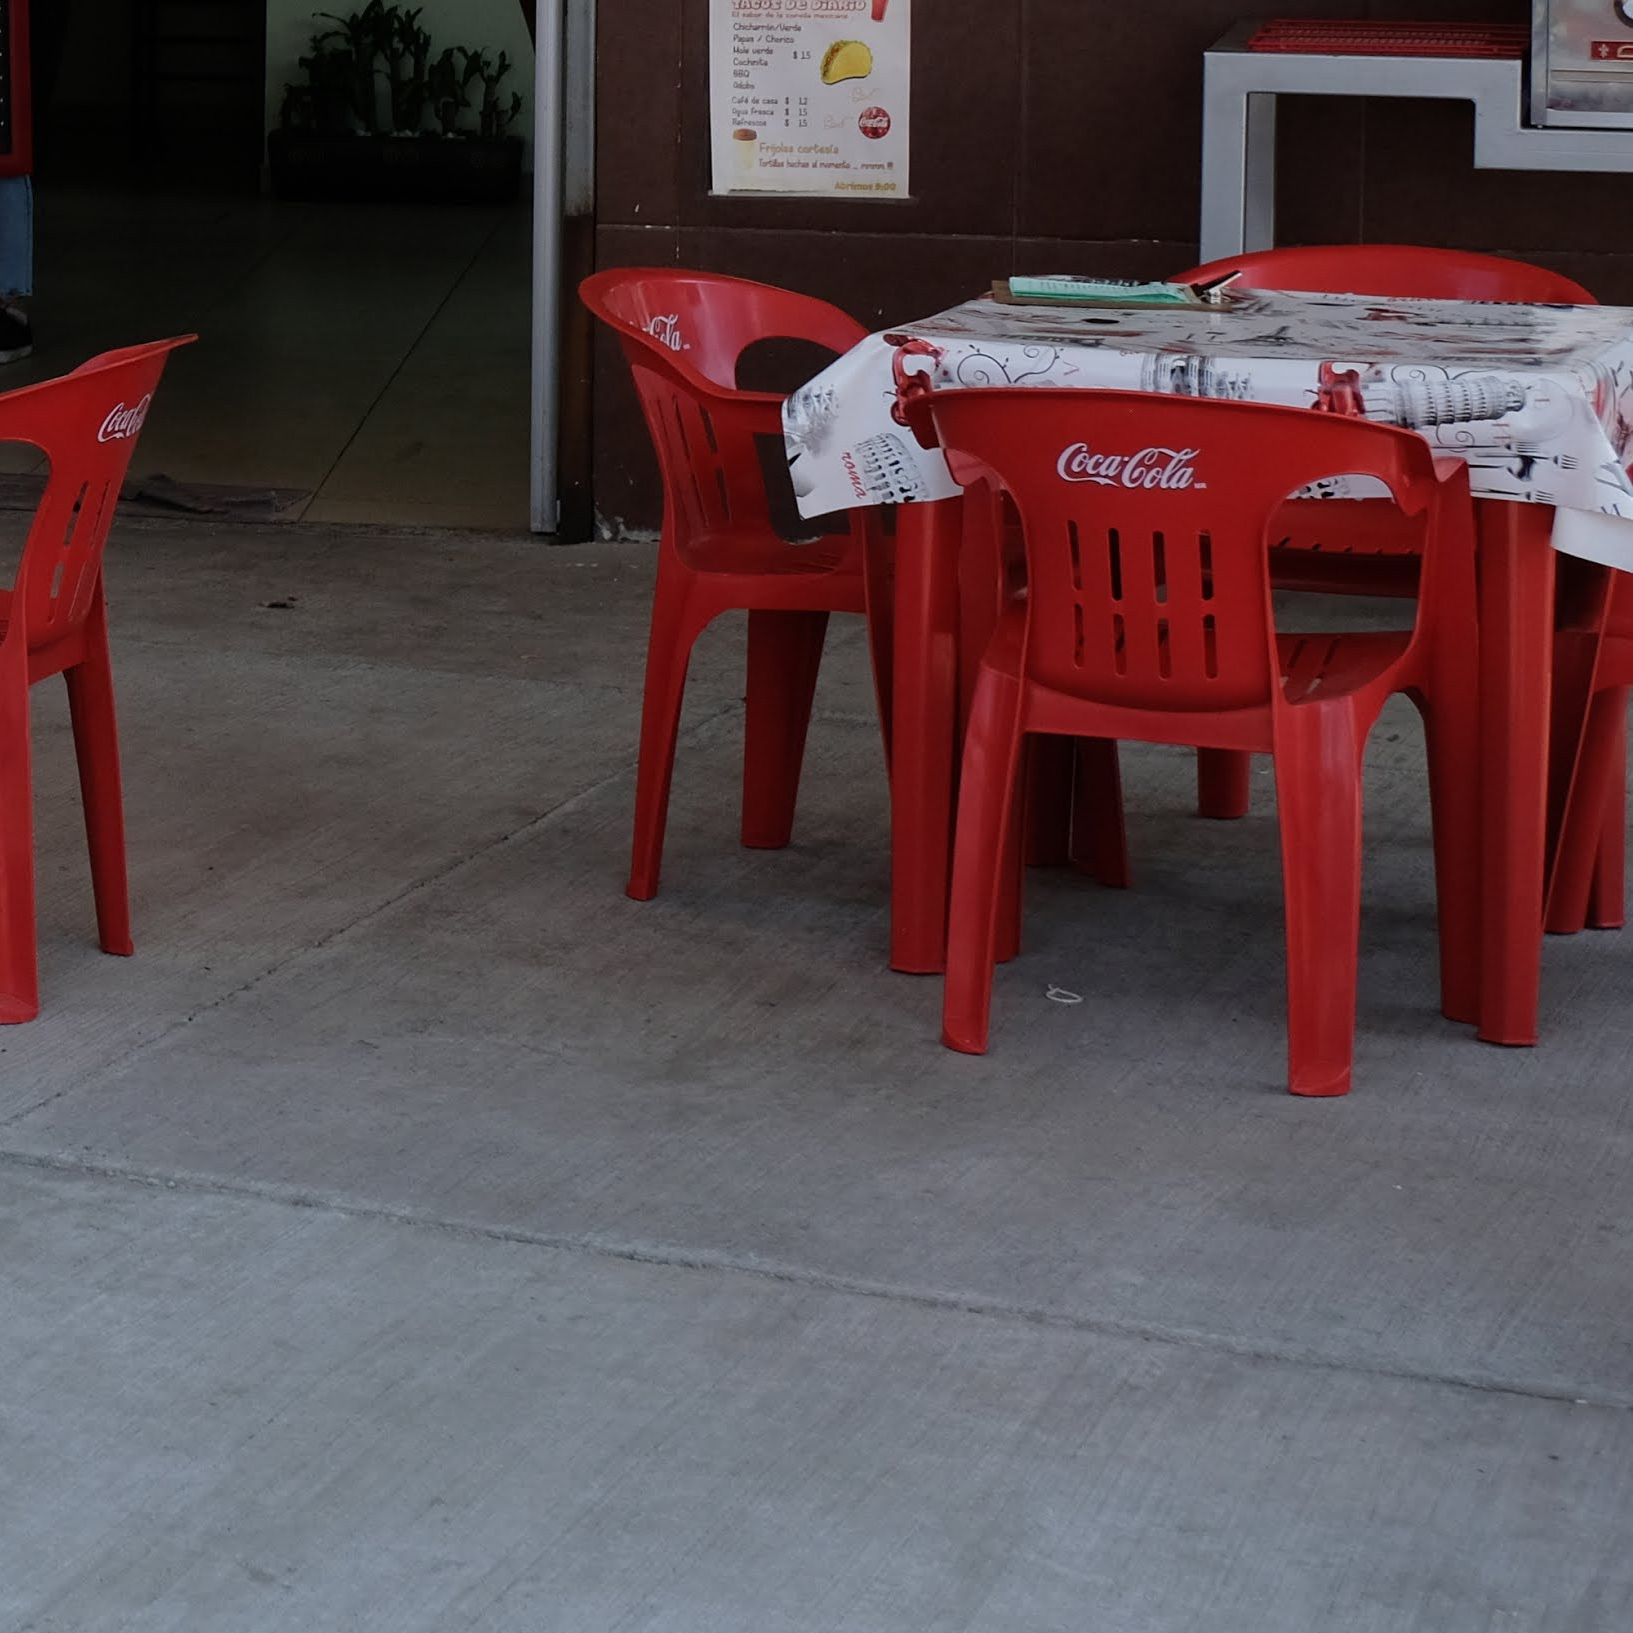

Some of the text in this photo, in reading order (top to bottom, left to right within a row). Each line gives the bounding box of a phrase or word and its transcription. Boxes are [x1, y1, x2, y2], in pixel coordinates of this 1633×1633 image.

[732, 0, 782, 10] TACOS
[801, 51, 811, 60] 15
[733, 69, 750, 78] BBQ
[798, 97, 808, 105] 12
[798, 108, 808, 116] 15
[798, 119, 808, 127] 15
[1057, 442, 1201, 490] Coca-Cola
